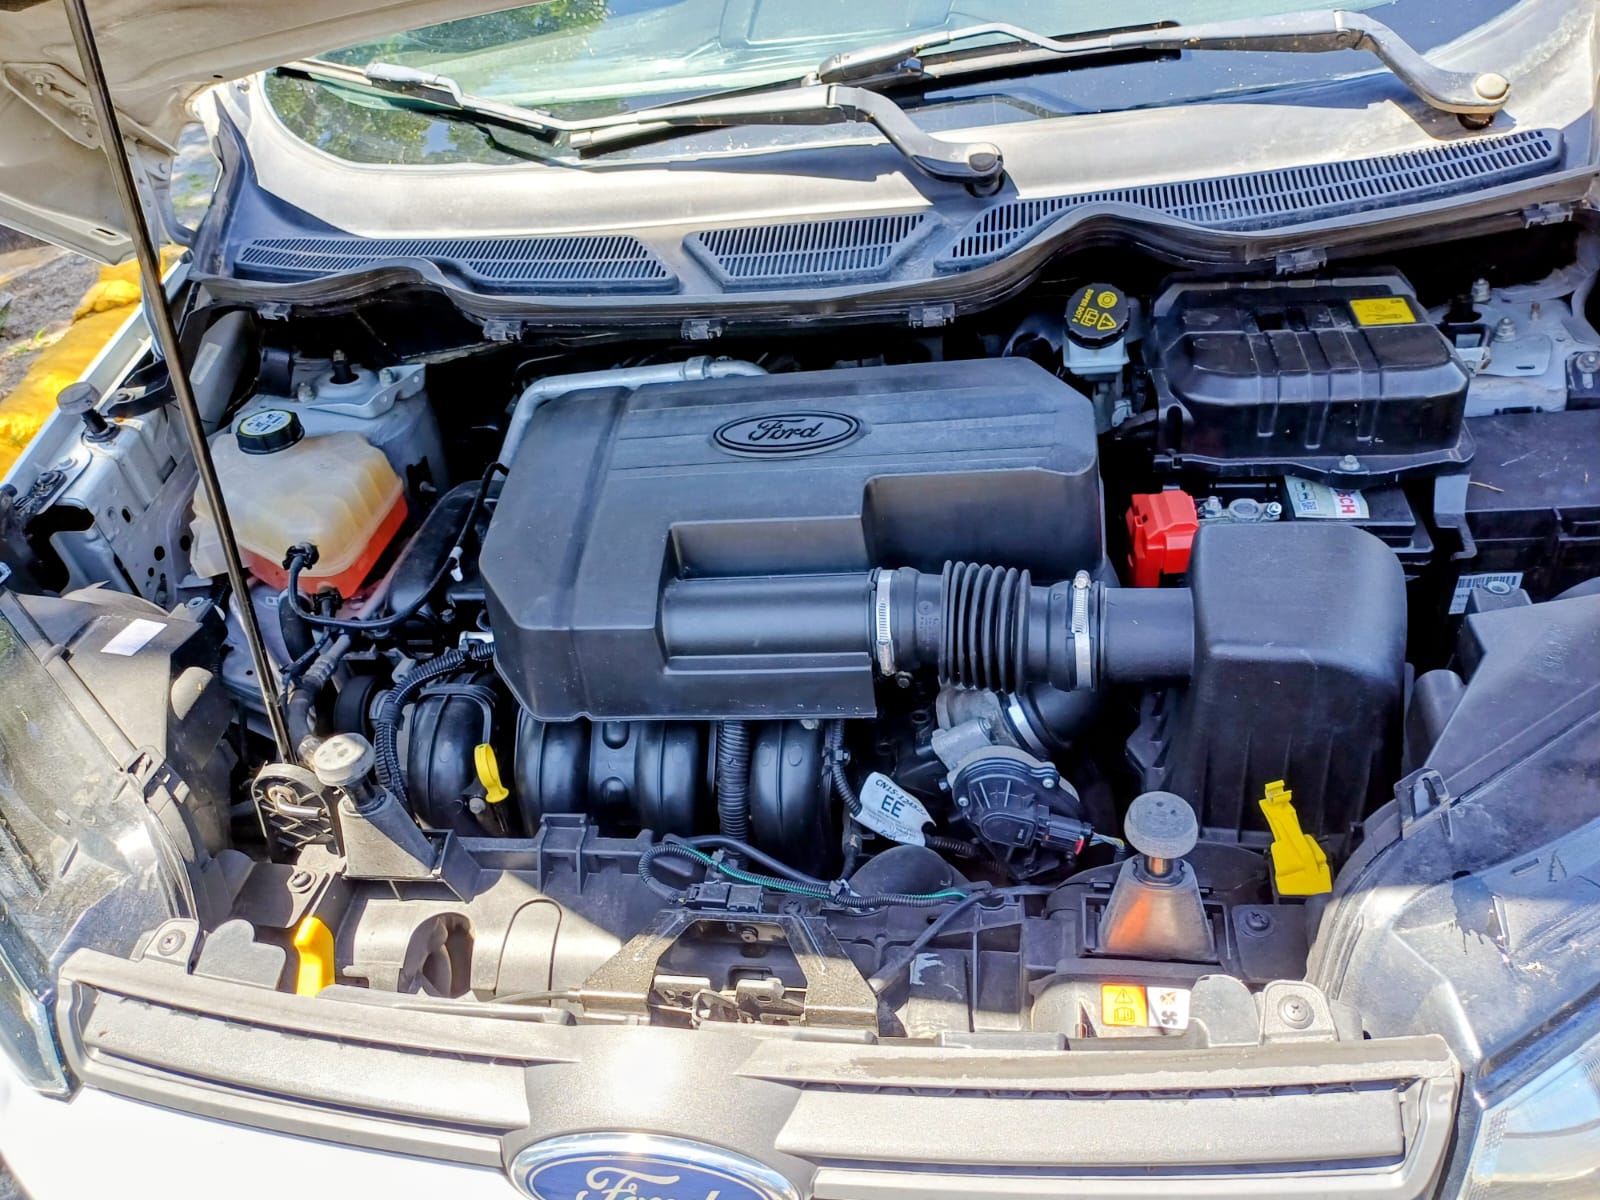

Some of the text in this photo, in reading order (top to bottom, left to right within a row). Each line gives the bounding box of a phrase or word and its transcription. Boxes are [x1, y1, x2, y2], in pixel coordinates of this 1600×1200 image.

[1074, 306, 1085, 319] DOT
[748, 418, 824, 441] Ford
[881, 794, 905, 818] EE
